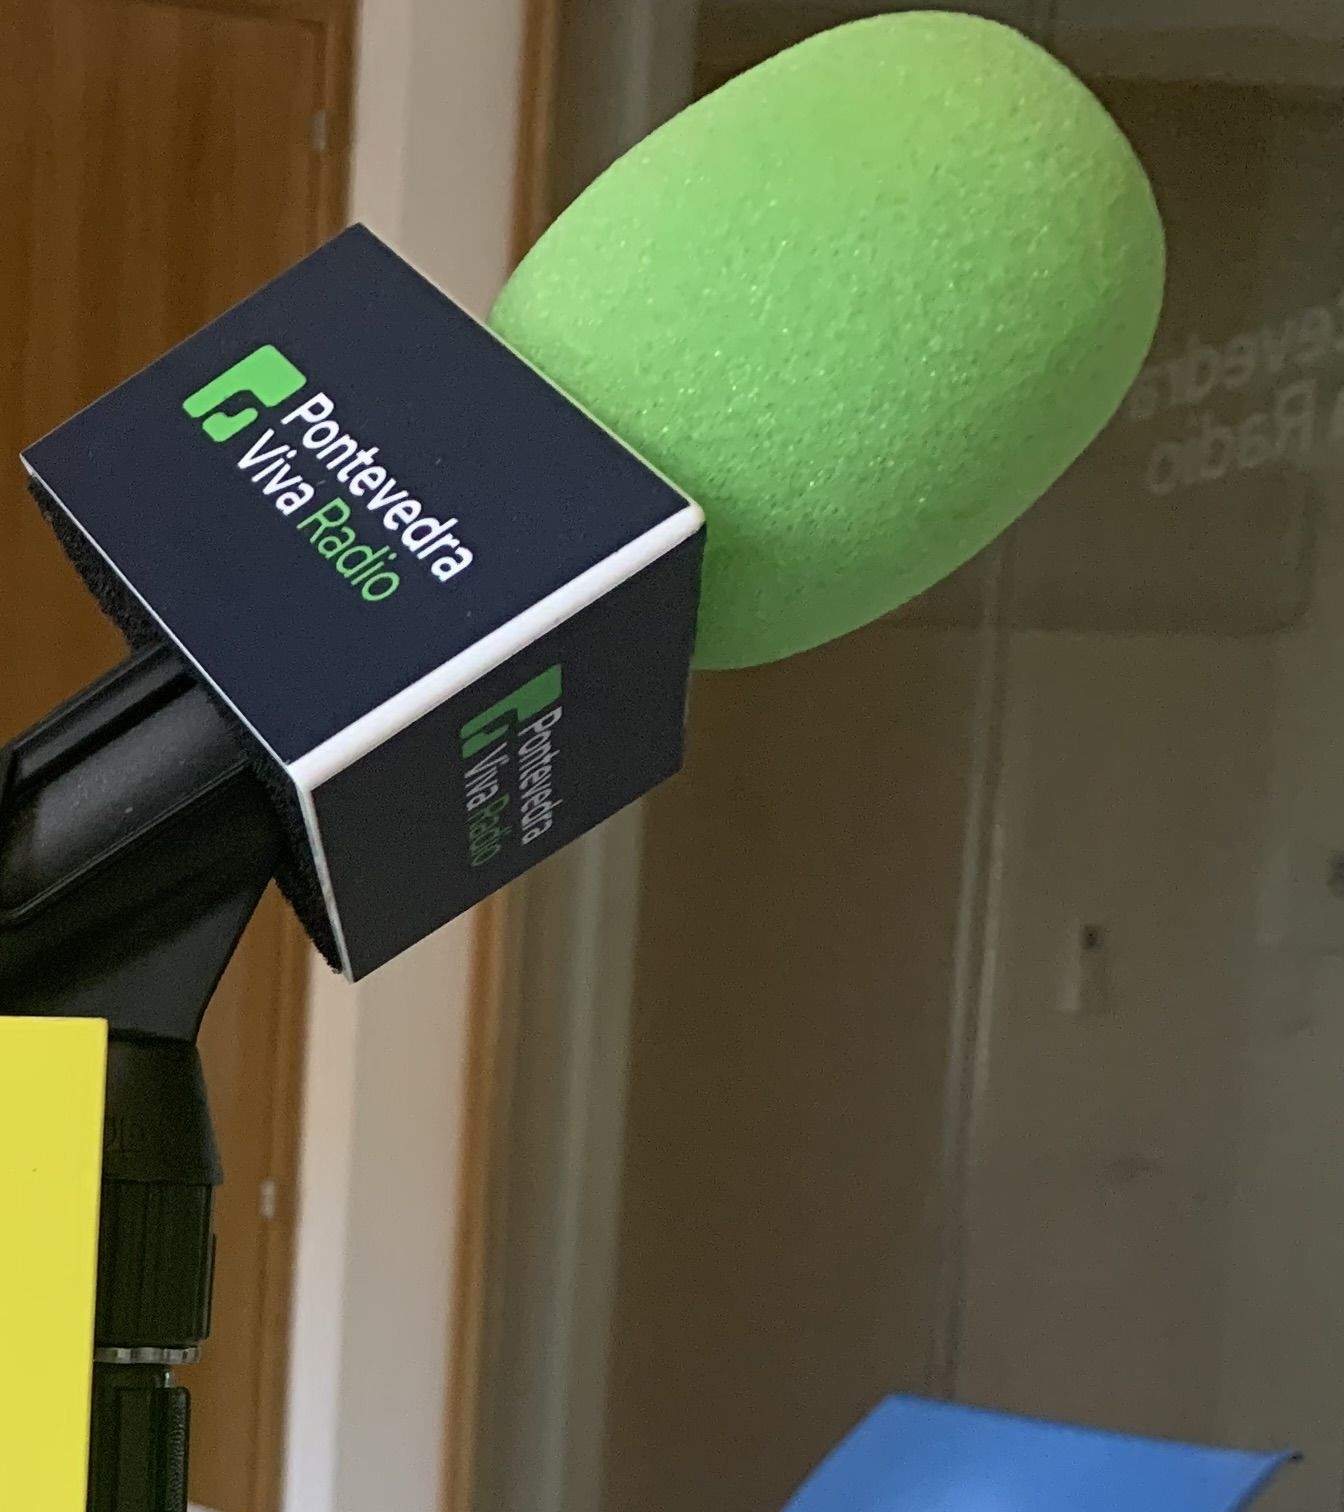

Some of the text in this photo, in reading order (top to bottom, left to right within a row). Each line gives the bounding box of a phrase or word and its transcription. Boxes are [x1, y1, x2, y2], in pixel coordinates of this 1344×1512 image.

[237, 428, 400, 601] Viva Radio
[280, 391, 473, 583] Pontevedra
[465, 742, 513, 867] Viva Radio
[518, 706, 562, 845] Pontevedra
